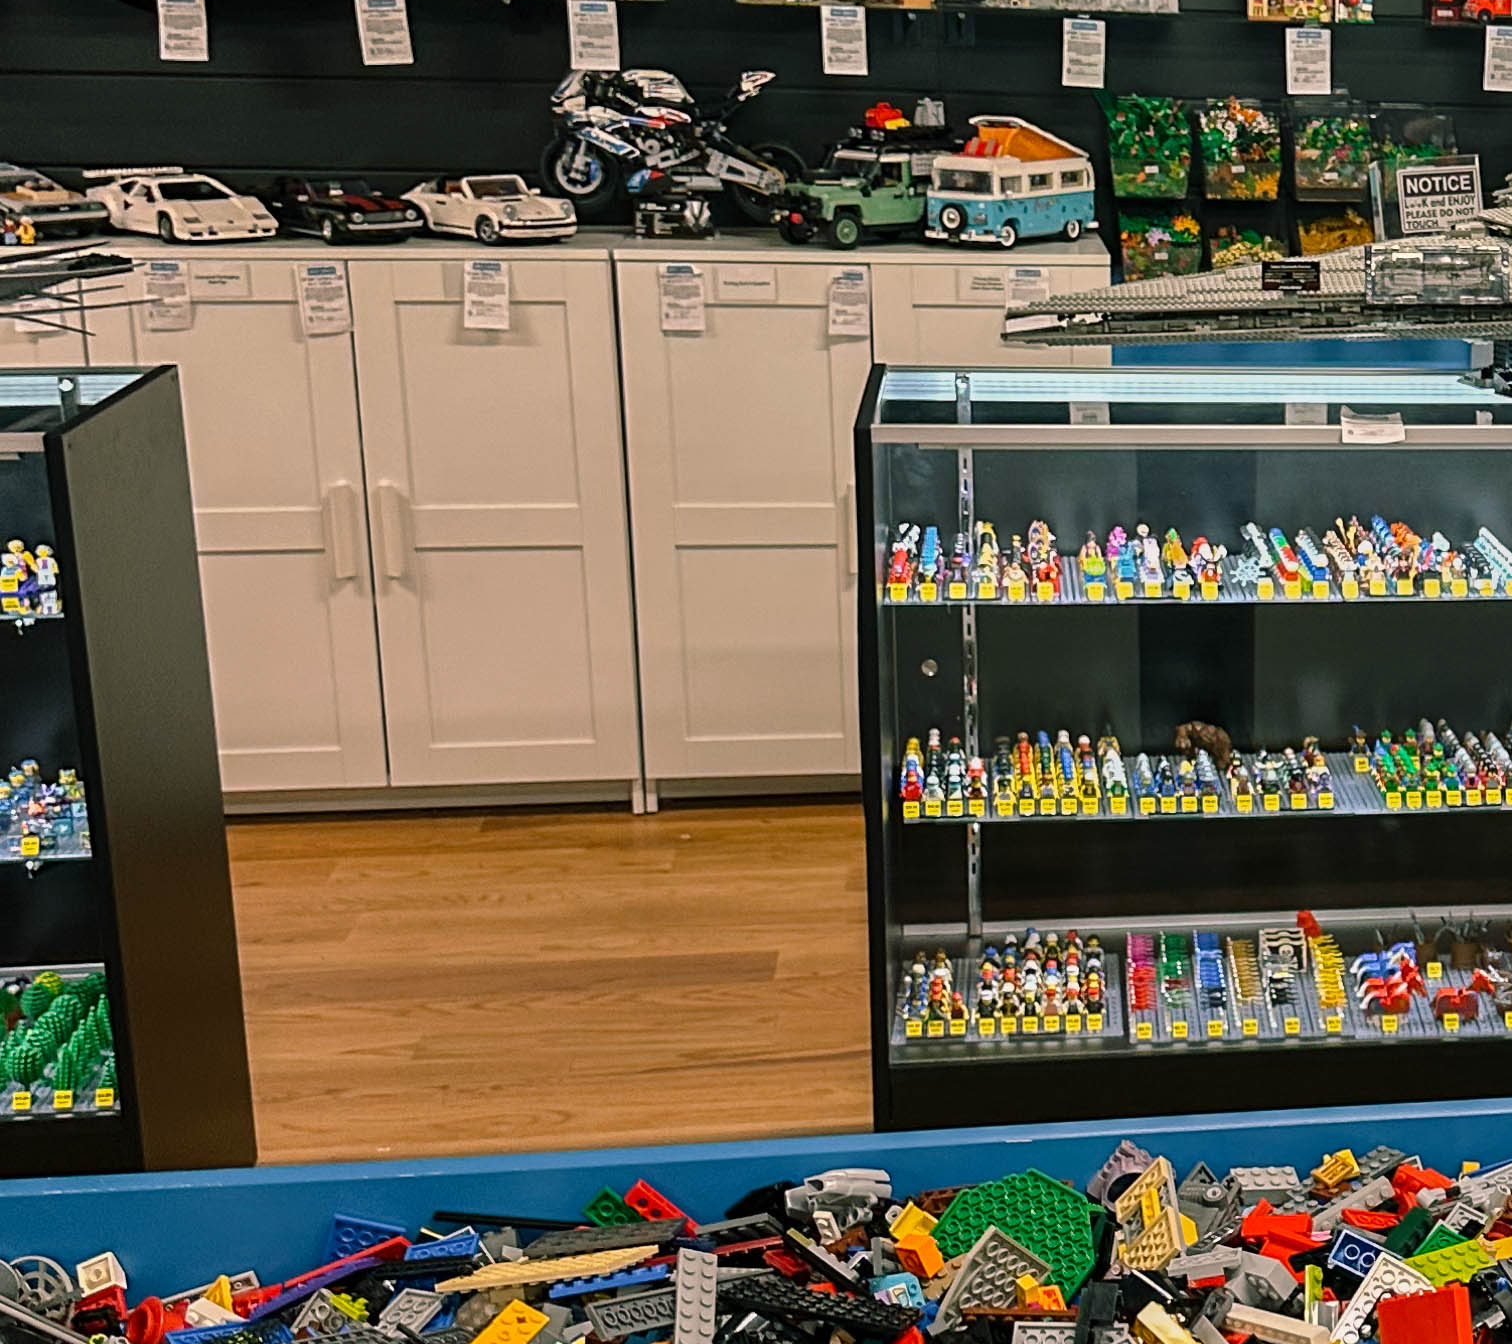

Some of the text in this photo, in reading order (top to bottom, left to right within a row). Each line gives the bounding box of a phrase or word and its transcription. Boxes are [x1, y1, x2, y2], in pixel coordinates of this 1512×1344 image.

[1405, 175, 1472, 194] NOTICE
[1447, 195, 1476, 206] ENJOY
[1405, 207, 1475, 219] PLEASE DO NOT
[1406, 219, 1439, 229] TOUCH
